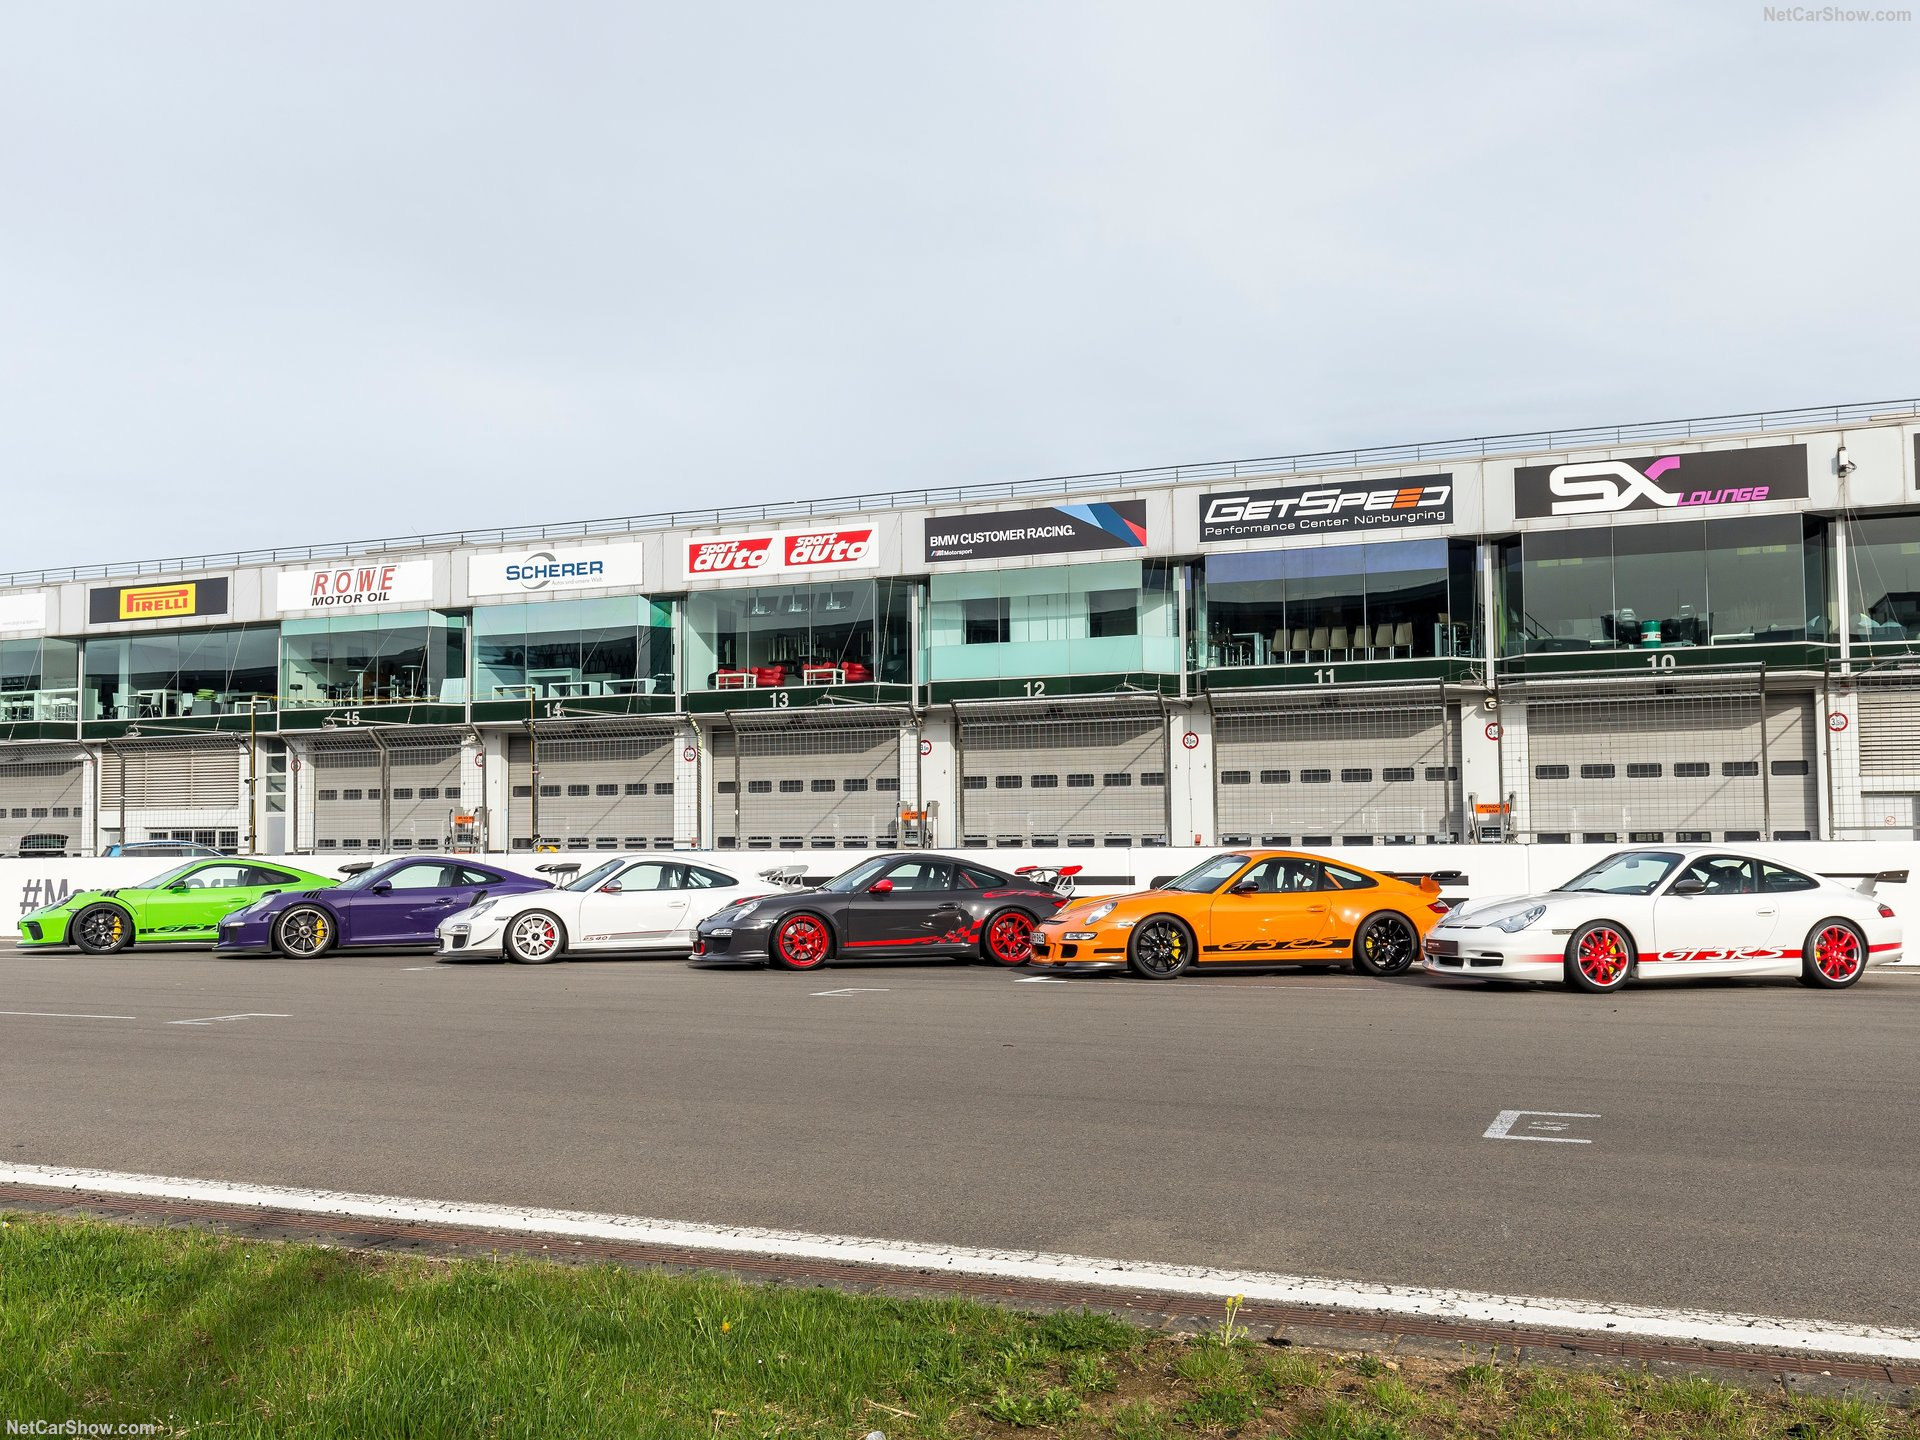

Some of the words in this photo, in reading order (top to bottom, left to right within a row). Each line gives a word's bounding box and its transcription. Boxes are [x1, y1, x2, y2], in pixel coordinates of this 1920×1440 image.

[1677, 486, 1769, 507] LOUNGE
[1205, 522, 1295, 536] Performance
[1300, 518, 1349, 529] Center
[1354, 510, 1446, 525] Nürburgring
[795, 533, 838, 549] sport
[930, 534, 959, 547] BMW
[960, 529, 1025, 544] CUSTOMER
[1027, 525, 1075, 538] RACING.
[699, 541, 739, 555] sport
[789, 541, 869, 564] auto
[693, 549, 770, 571] auto
[311, 565, 397, 596] ROWE
[506, 560, 604, 581] SCHERER
[126, 589, 189, 613] PIRELLI
[311, 593, 363, 606] MOTOR
[367, 592, 390, 602] OIL
[1647, 654, 1676, 673] 10
[1314, 668, 1335, 684] 11
[1023, 681, 1045, 697] 12
[769, 692, 789, 708] 13
[344, 711, 360, 726] 15
